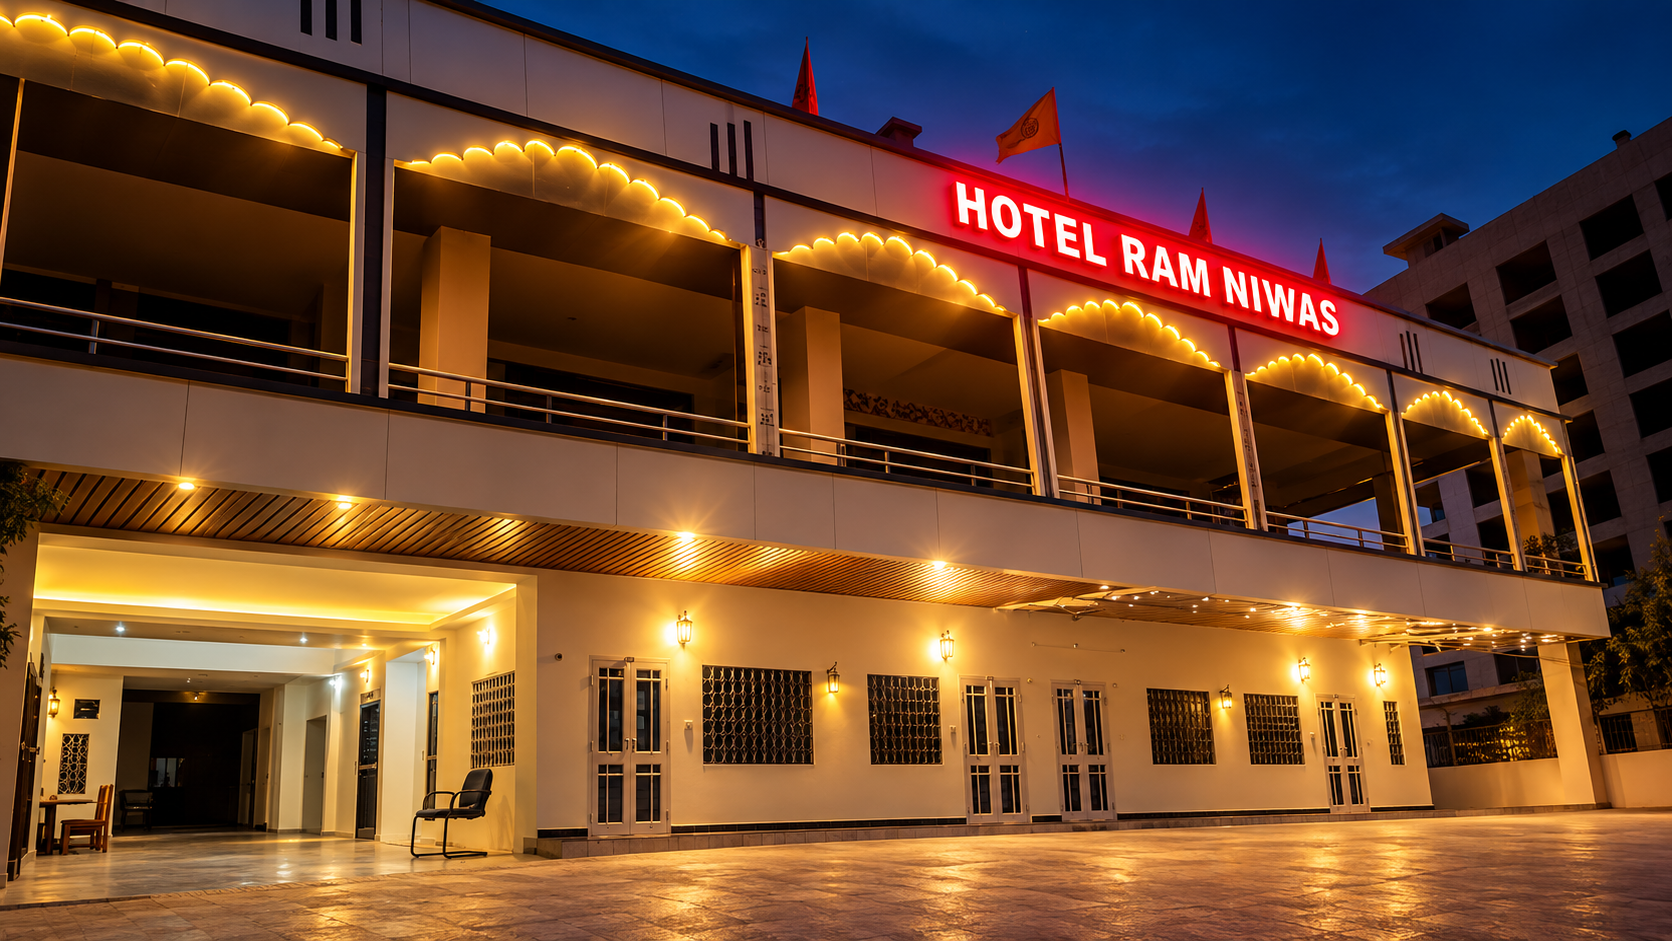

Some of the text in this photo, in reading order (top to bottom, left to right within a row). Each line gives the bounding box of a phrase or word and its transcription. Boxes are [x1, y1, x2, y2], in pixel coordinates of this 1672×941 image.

[955, 182, 1340, 335] HOTEL RAM NIWAS
